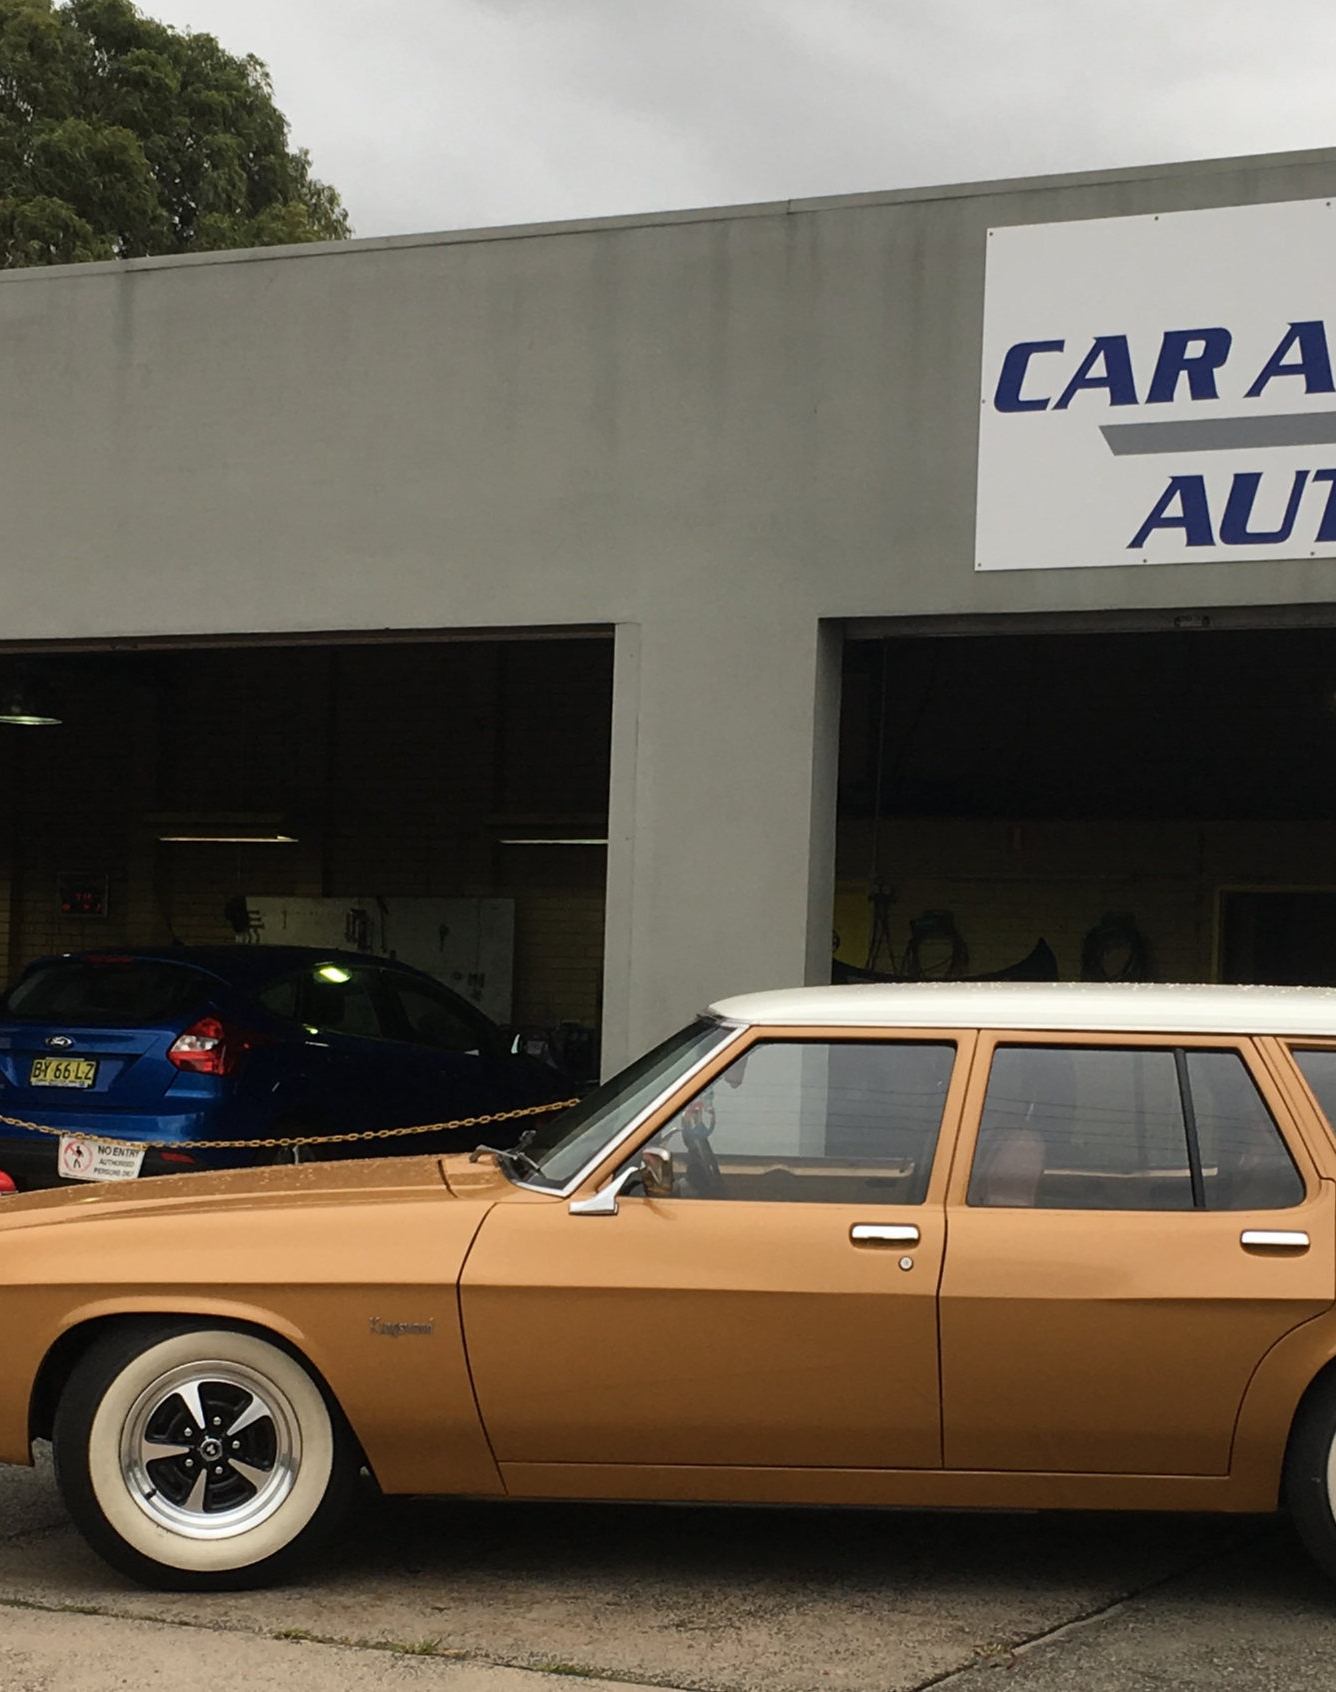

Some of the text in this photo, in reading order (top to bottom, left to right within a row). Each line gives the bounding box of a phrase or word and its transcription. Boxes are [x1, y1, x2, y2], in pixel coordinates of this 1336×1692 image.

[994, 326, 1233, 412] CAR
[32, 1061, 95, 1081] BY 66 LZ
[97, 1145, 140, 1158] NO ENTRY
[93, 1167, 120, 1176] PERSONS
